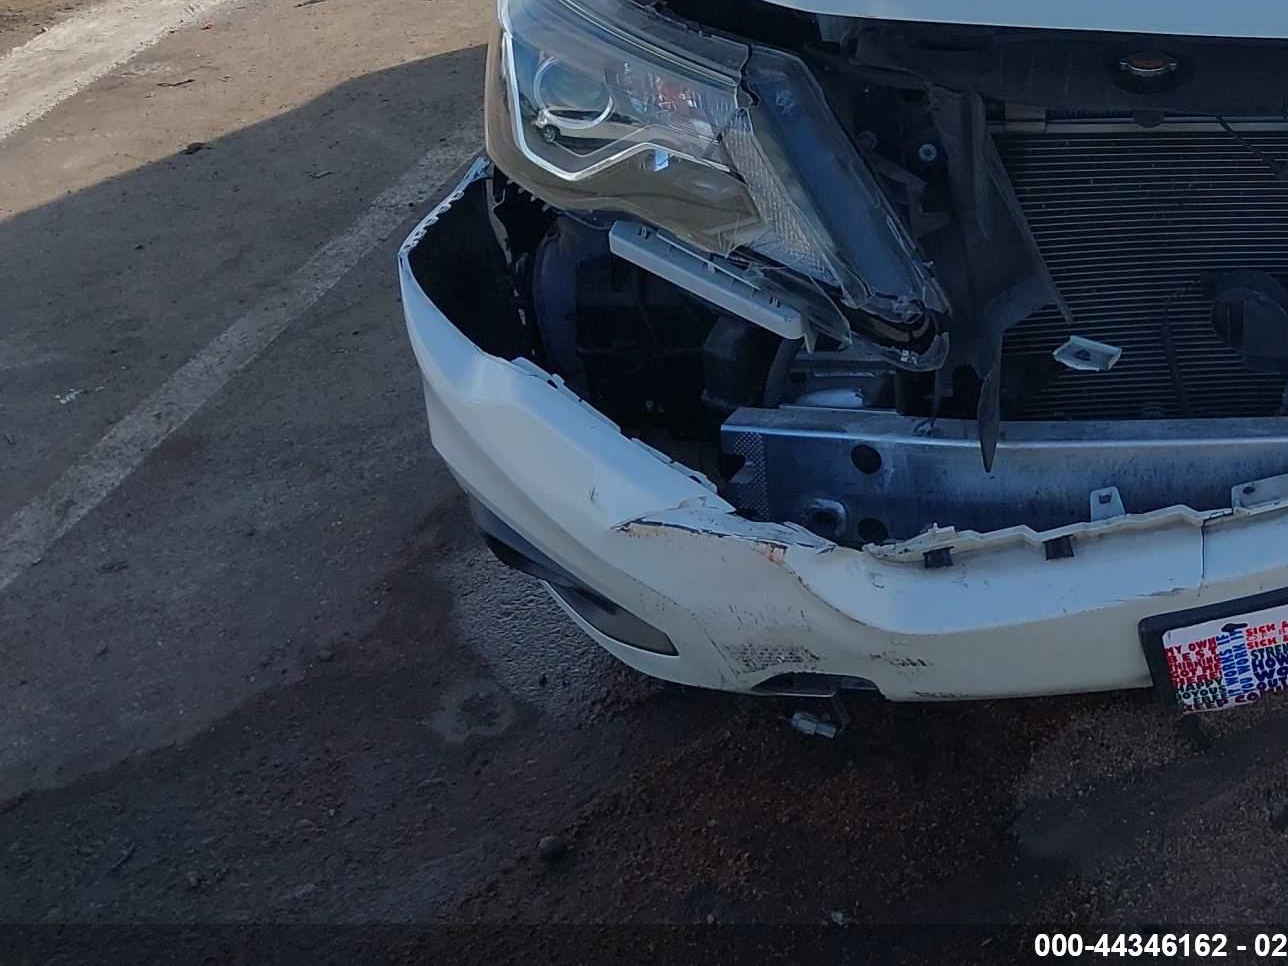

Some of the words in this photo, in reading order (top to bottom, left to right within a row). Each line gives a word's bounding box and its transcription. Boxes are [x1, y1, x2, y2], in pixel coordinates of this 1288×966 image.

[1246, 624, 1276, 637] SICK
[1164, 645, 1182, 659] MY
[1188, 637, 1217, 652] OWN
[1247, 637, 1277, 650] SICK
[1168, 654, 1221, 674] THINKING
[1219, 648, 1239, 687] WORKS
[1232, 643, 1251, 675] WORK
[1239, 677, 1257, 695] YOU
[1256, 676, 1288, 691] OUT
